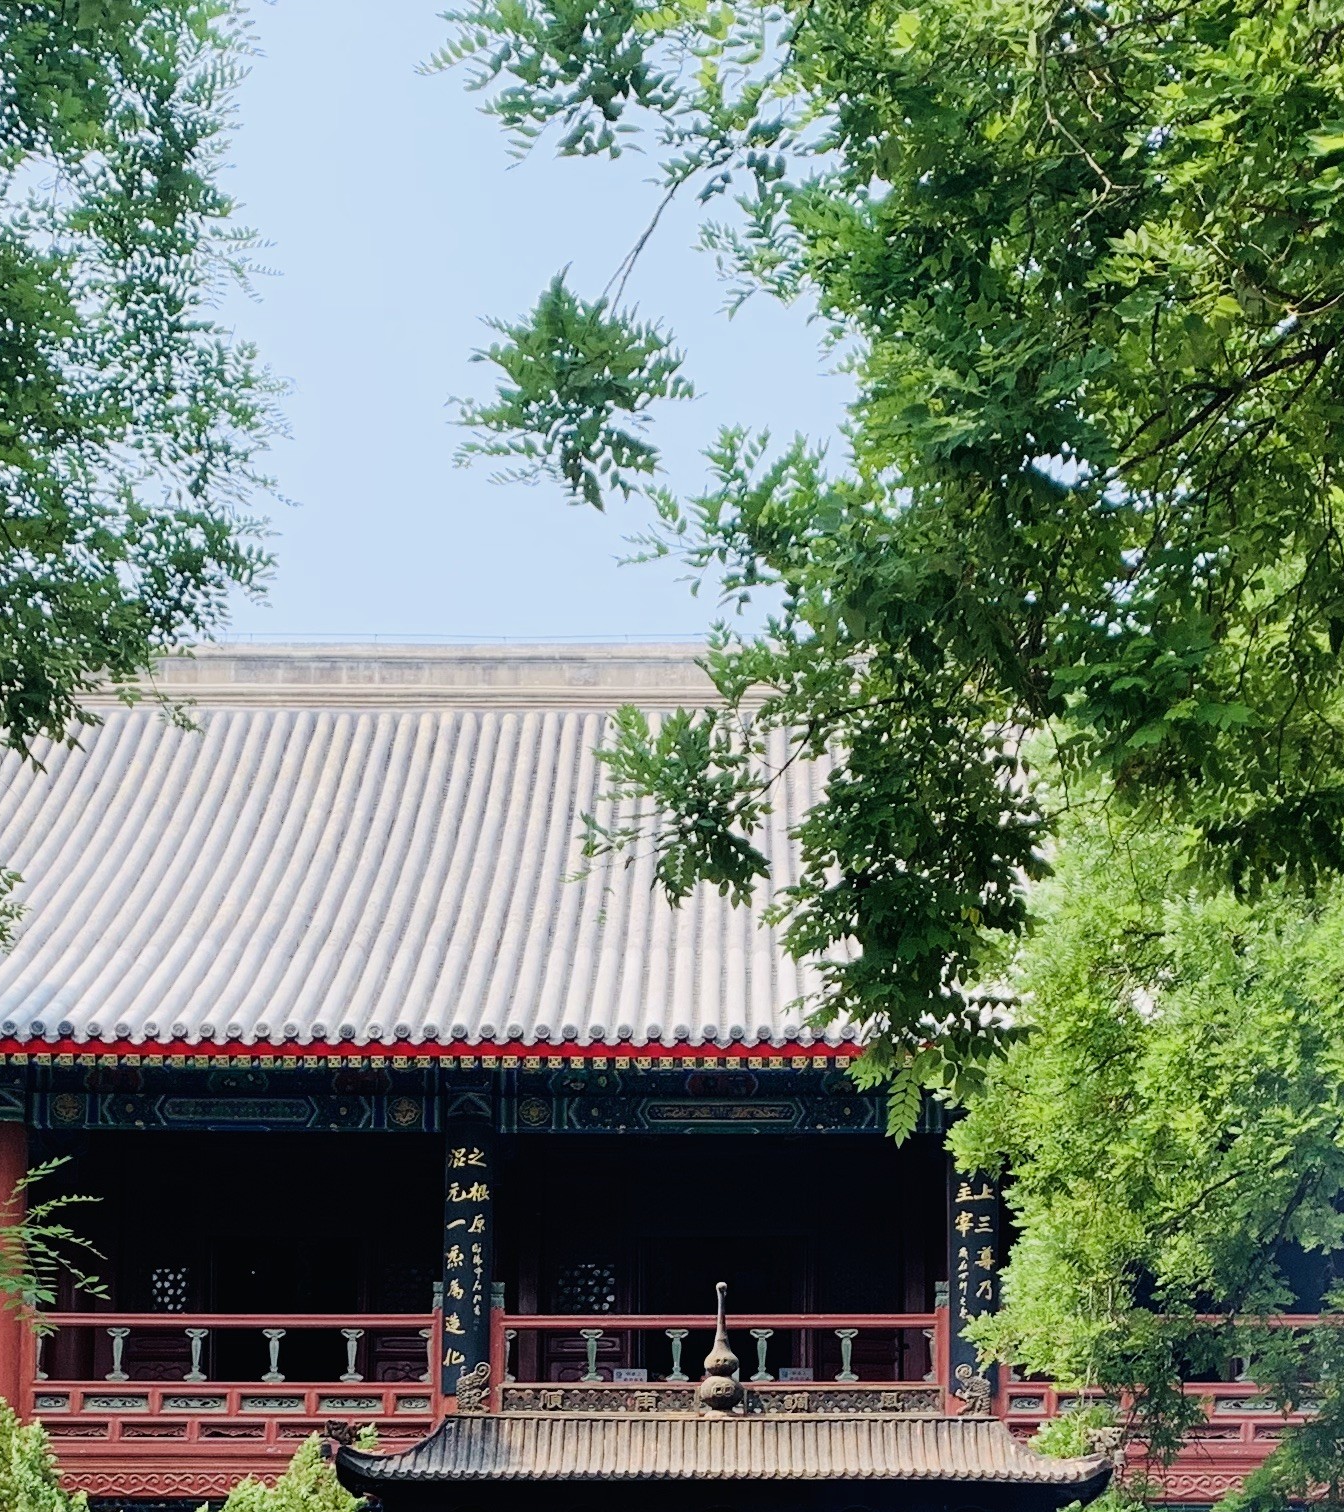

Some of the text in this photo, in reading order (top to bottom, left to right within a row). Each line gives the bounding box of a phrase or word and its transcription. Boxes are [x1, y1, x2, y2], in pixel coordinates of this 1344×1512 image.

[955, 1182, 974, 1238] 主宰
[973, 1183, 996, 1300] 上三尊乃
